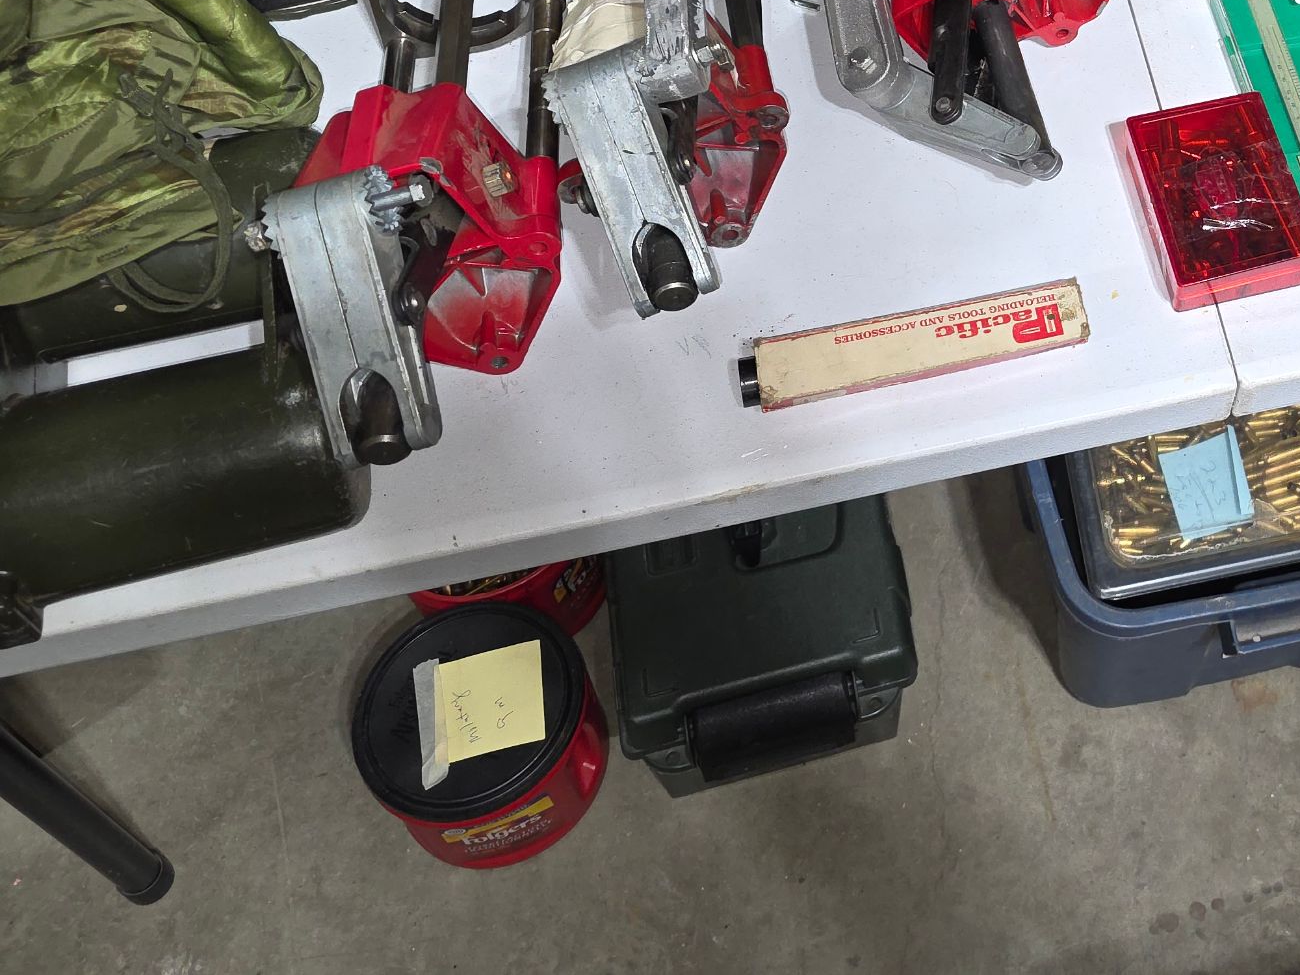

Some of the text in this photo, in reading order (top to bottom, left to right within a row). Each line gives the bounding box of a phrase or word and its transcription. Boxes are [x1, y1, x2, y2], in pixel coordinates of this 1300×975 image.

[834, 294, 1057, 345] RELOADING TOOLS AND ACCESSORIES
[935, 303, 1065, 344] Pacific
[461, 814, 542, 845] Folgers
